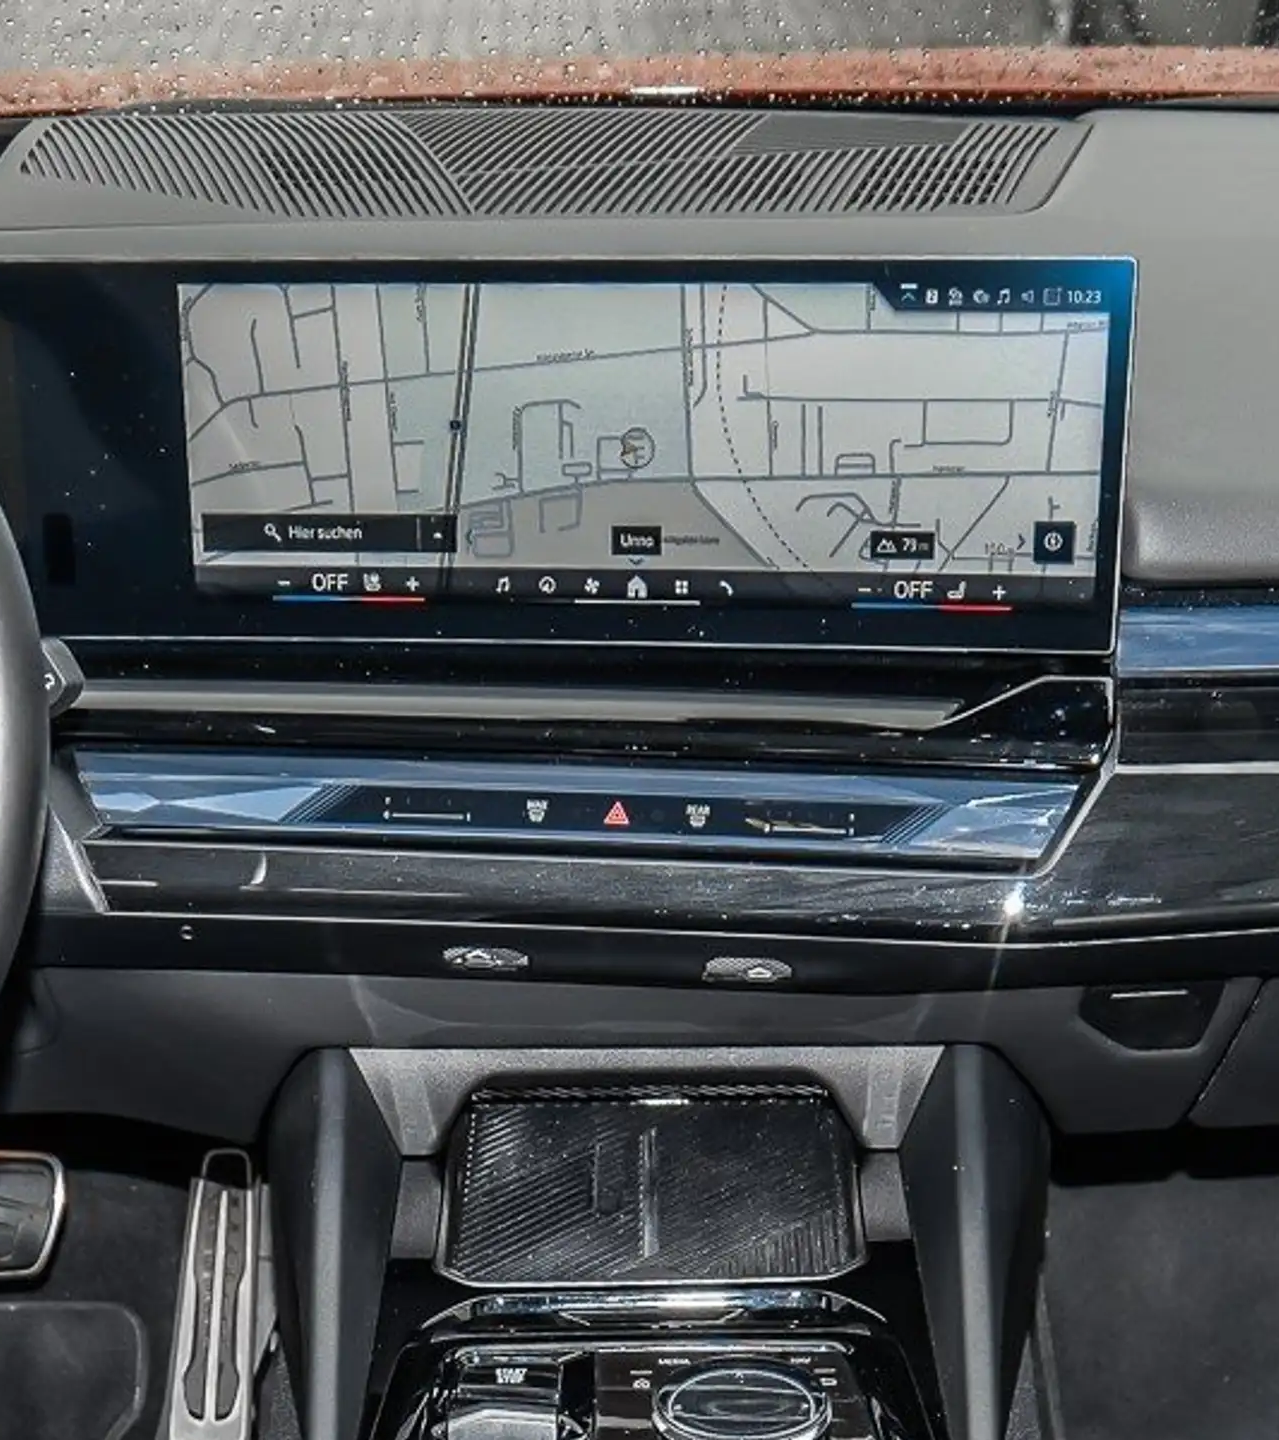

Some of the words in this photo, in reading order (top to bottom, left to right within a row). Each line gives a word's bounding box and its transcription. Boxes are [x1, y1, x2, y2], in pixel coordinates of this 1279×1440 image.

[1067, 290, 1102, 304] 10:23
[288, 524, 315, 540] Hier
[317, 524, 363, 541] suchen
[311, 573, 349, 592] OFF
[893, 580, 934, 600] OFF
